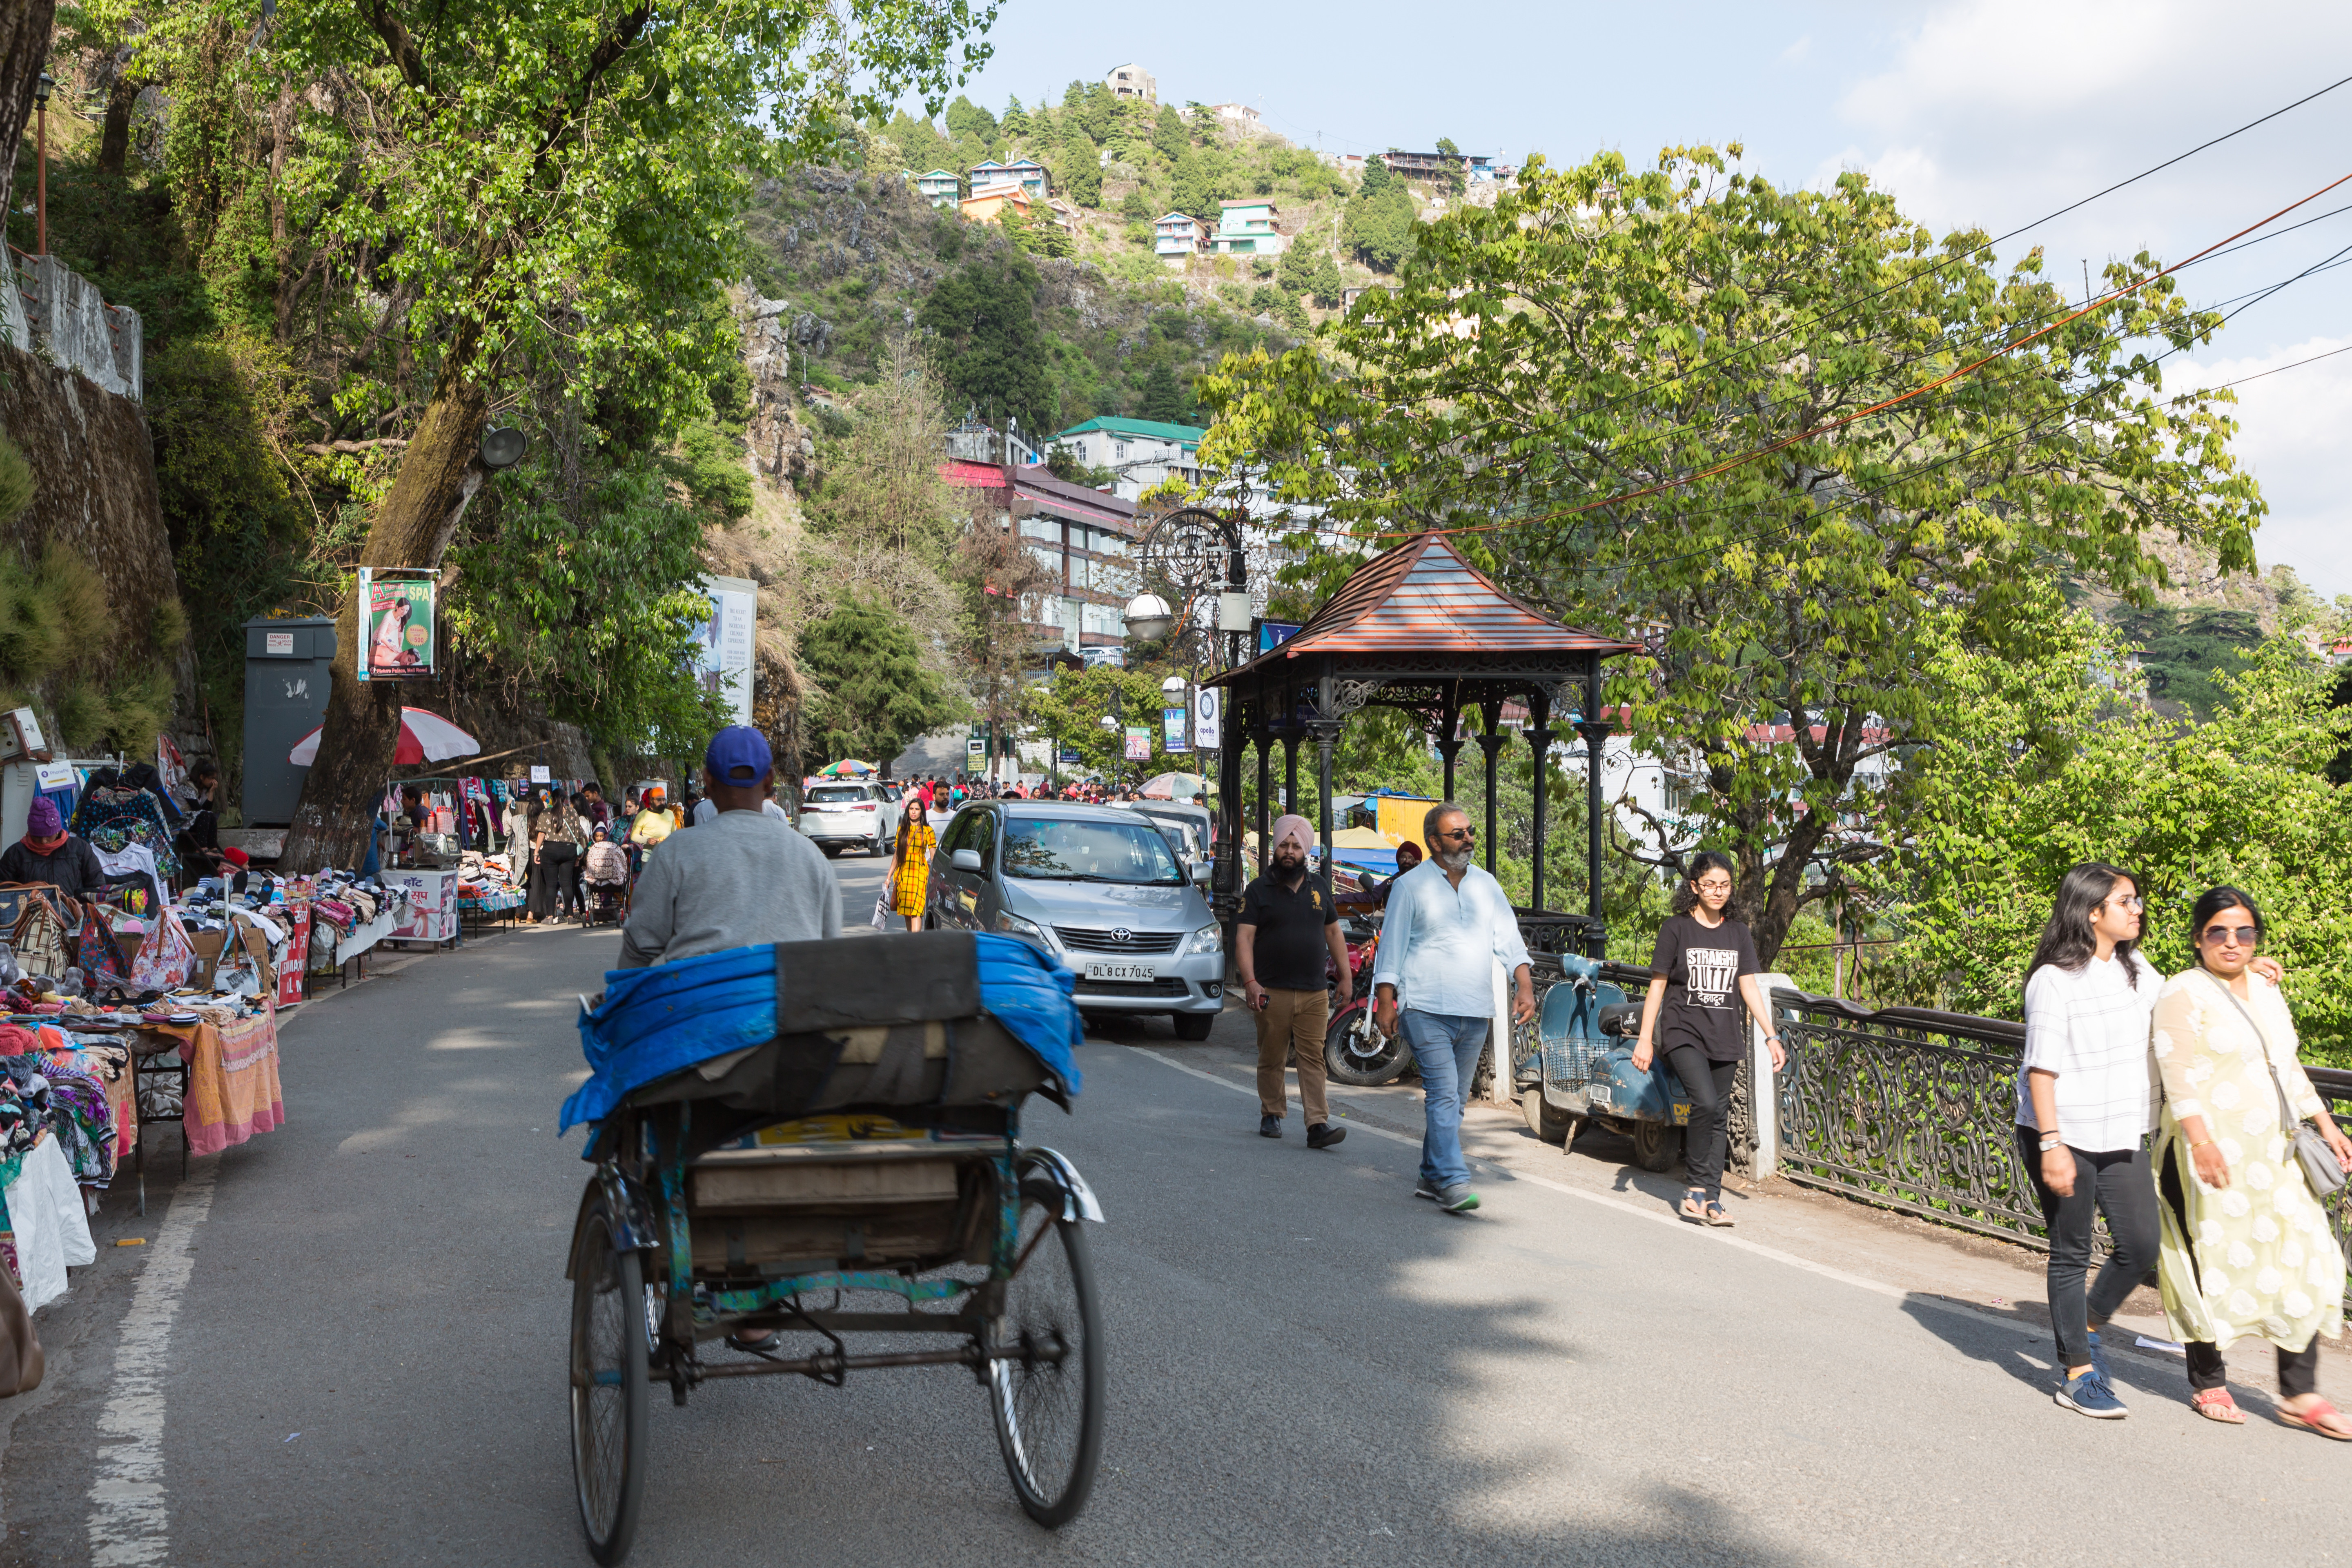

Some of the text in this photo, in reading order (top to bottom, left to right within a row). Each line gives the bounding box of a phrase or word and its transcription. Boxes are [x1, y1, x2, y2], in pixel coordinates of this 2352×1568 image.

[409, 586, 430, 601] SPA
[1200, 726, 1214, 735] apollo
[411, 891, 428, 904] सूप
[1238, 897, 1246, 913] 3
[1688, 949, 1738, 967] STRAIGHT
[1129, 968, 1153, 978] 7045
[1690, 966, 1734, 991] OUTTA
